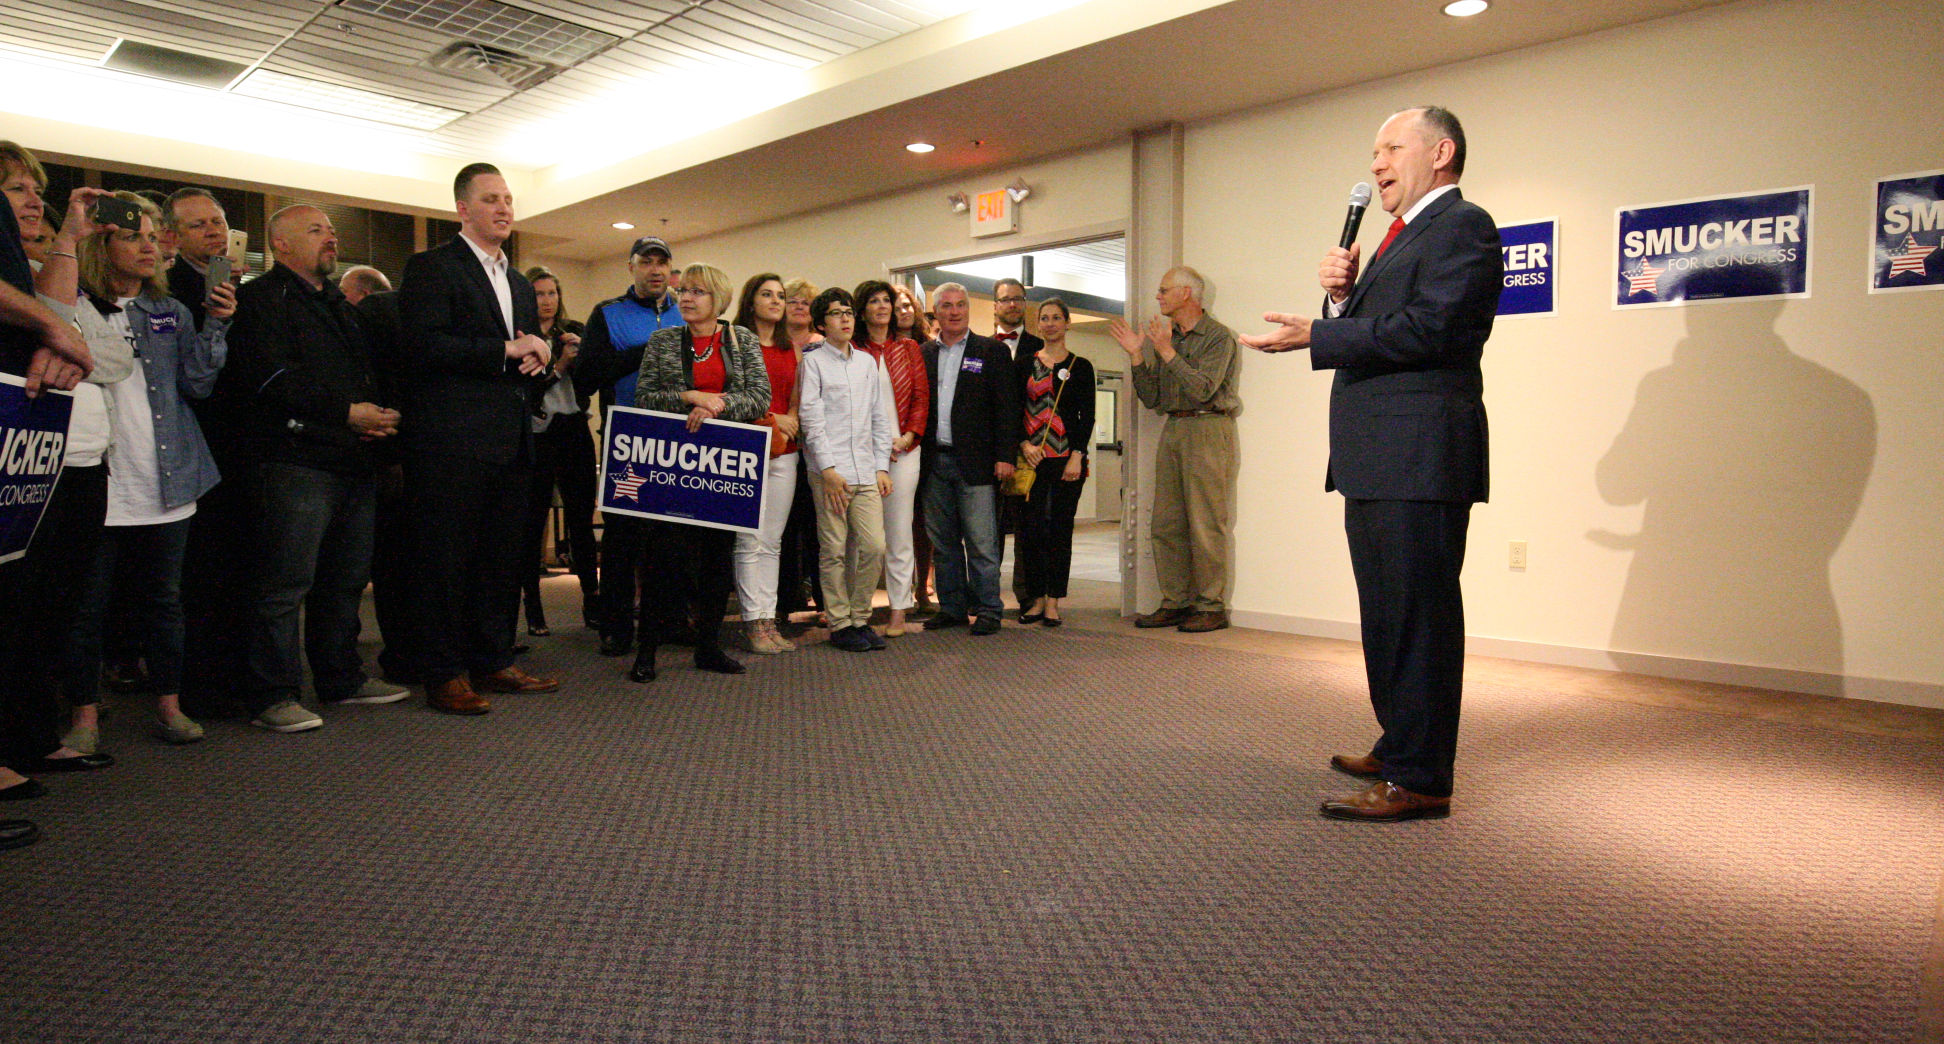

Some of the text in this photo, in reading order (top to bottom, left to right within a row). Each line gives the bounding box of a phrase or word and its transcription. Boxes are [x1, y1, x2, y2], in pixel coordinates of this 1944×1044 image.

[977, 189, 1006, 222] EXIT
[1624, 215, 1801, 258] SMUCKER
[1668, 248, 1797, 272] FOR CONGRESS
[613, 433, 759, 481] SMUCKER
[649, 470, 754, 498] FOR CONGRESS
